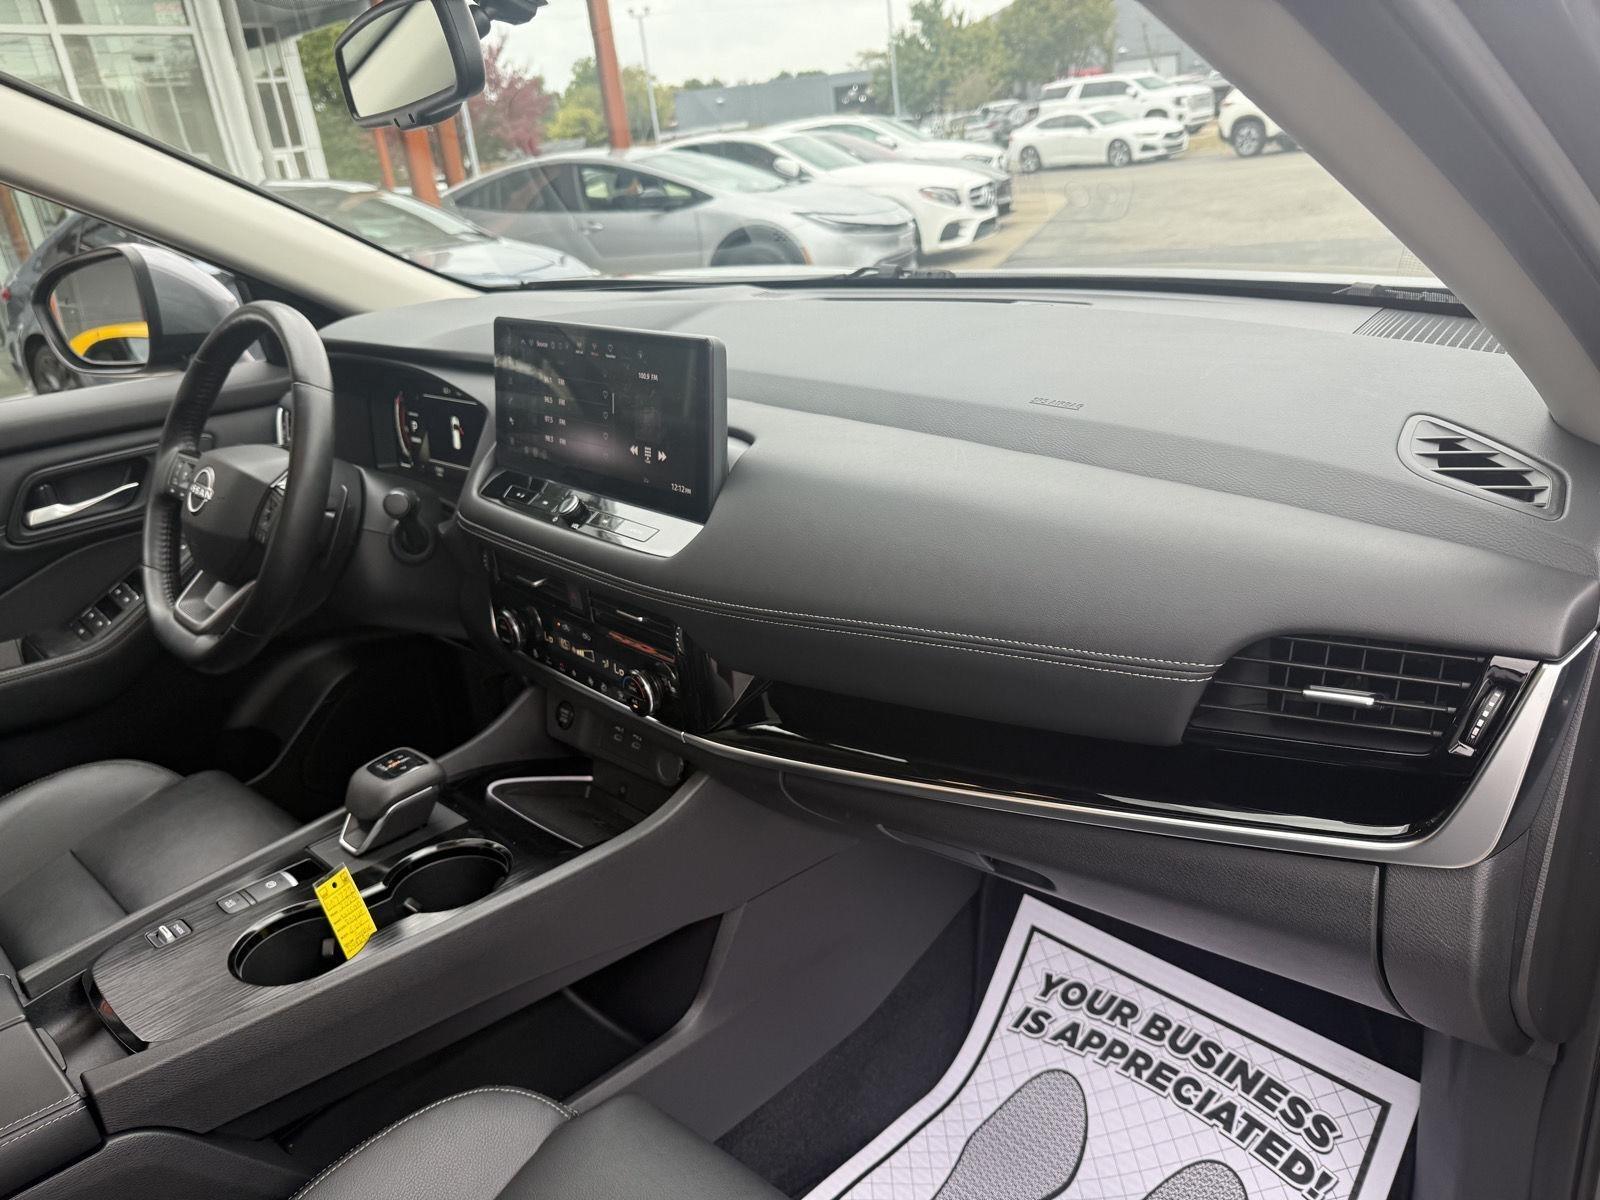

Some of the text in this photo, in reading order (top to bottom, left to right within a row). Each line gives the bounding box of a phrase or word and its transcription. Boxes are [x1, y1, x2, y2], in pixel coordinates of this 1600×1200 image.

[1012, 1006, 1338, 1200] IS APPRECIATED!
[1039, 972, 1341, 1151] YOUR BUSINESS
